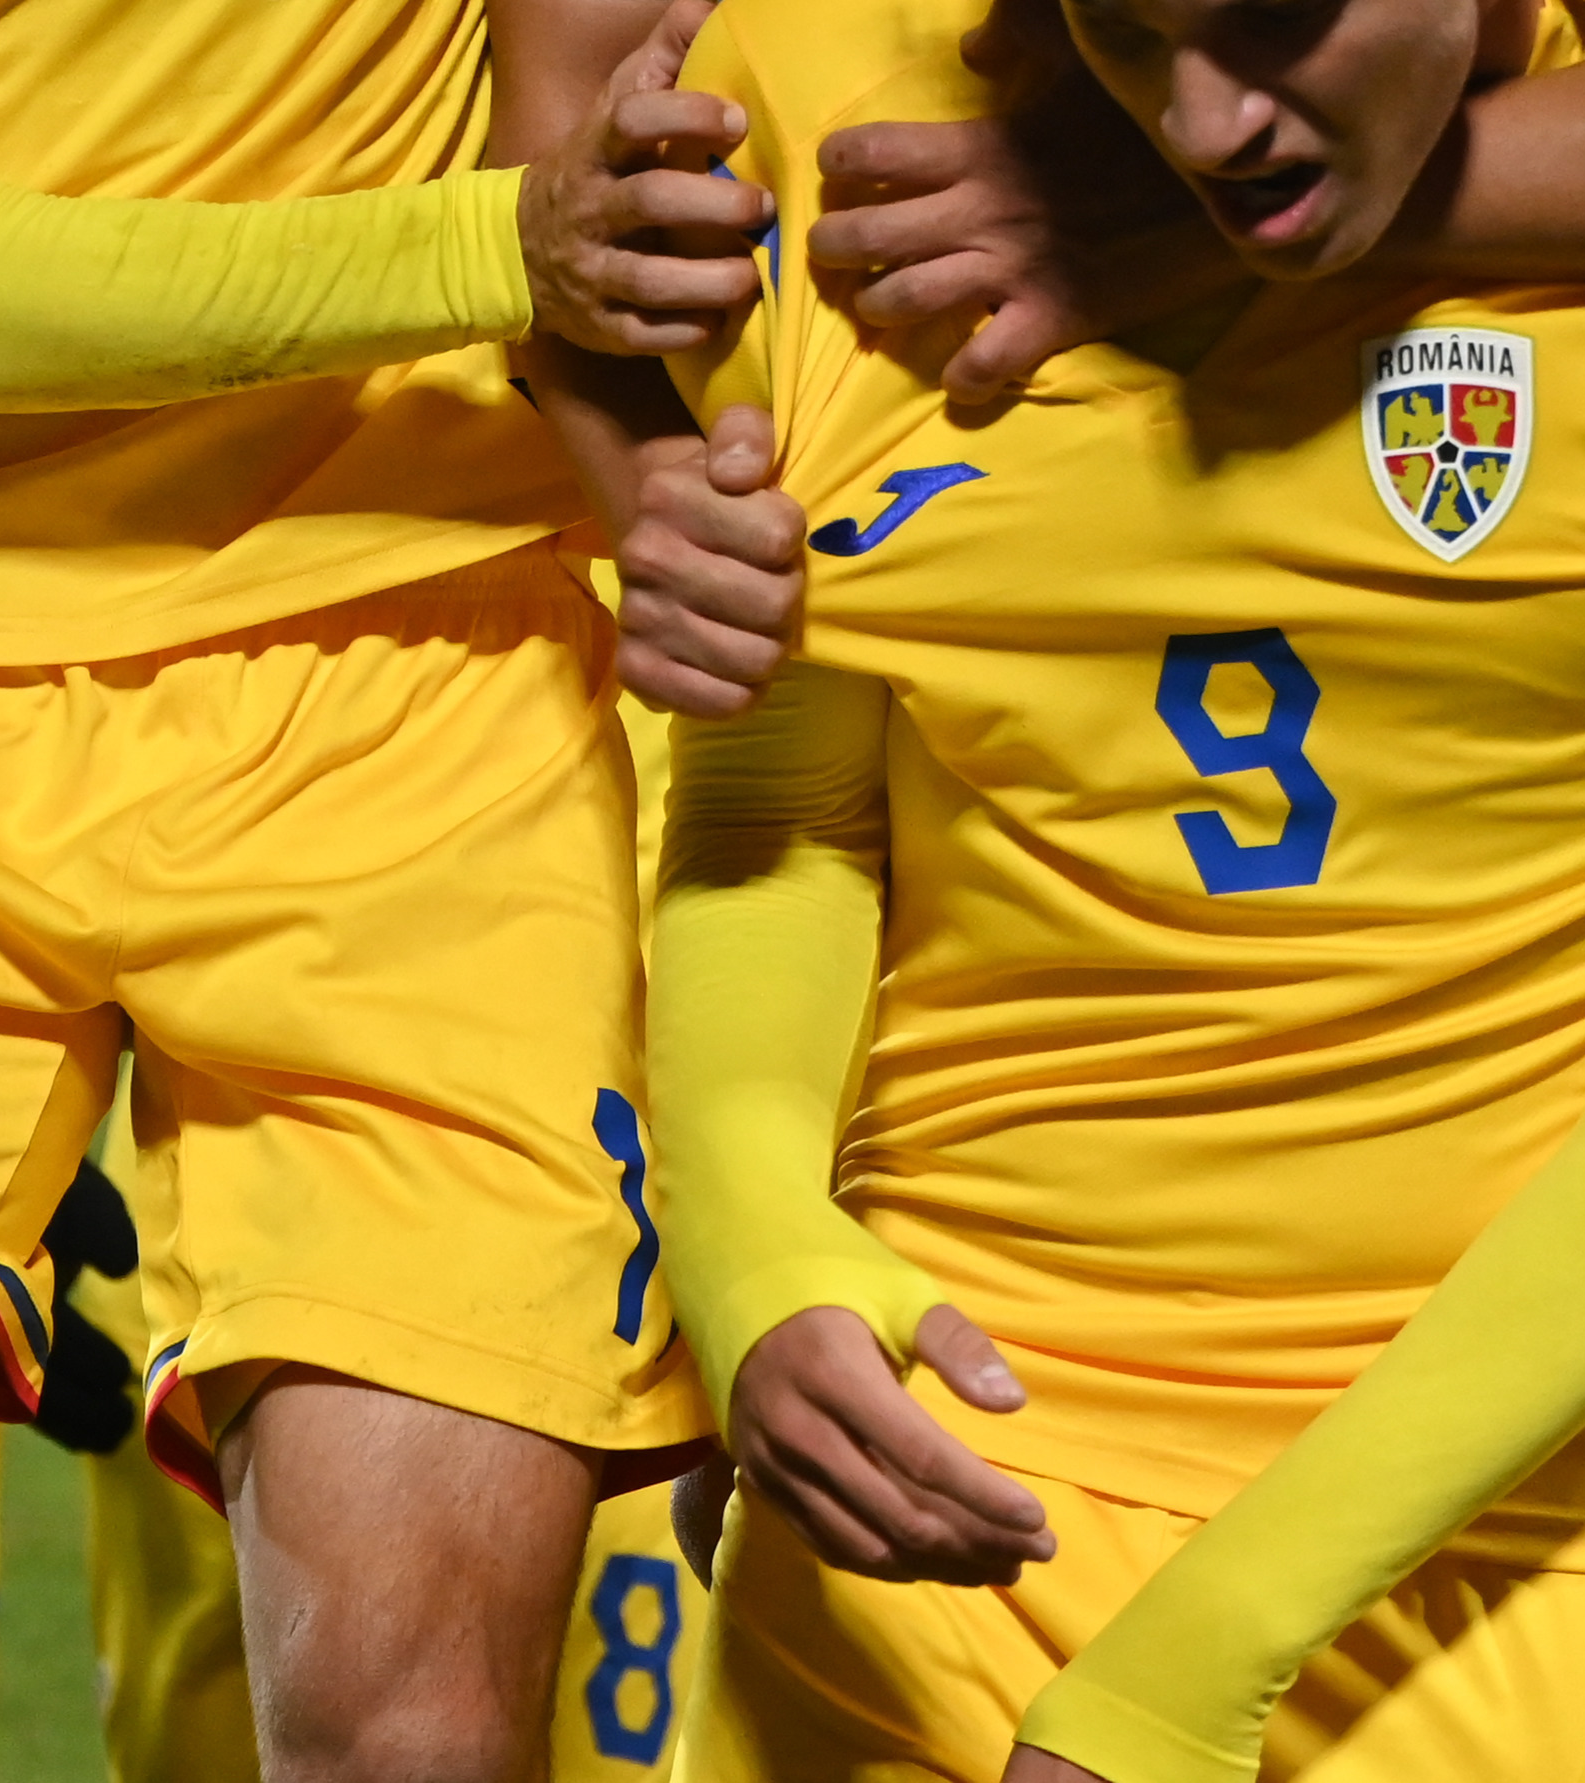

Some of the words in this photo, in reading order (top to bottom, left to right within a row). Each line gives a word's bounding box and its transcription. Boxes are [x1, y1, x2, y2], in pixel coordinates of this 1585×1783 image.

[1376, 333, 1515, 381] ROMÂNIA
[1154, 627, 1338, 896] 9
[586, 1553, 681, 1766] 8
